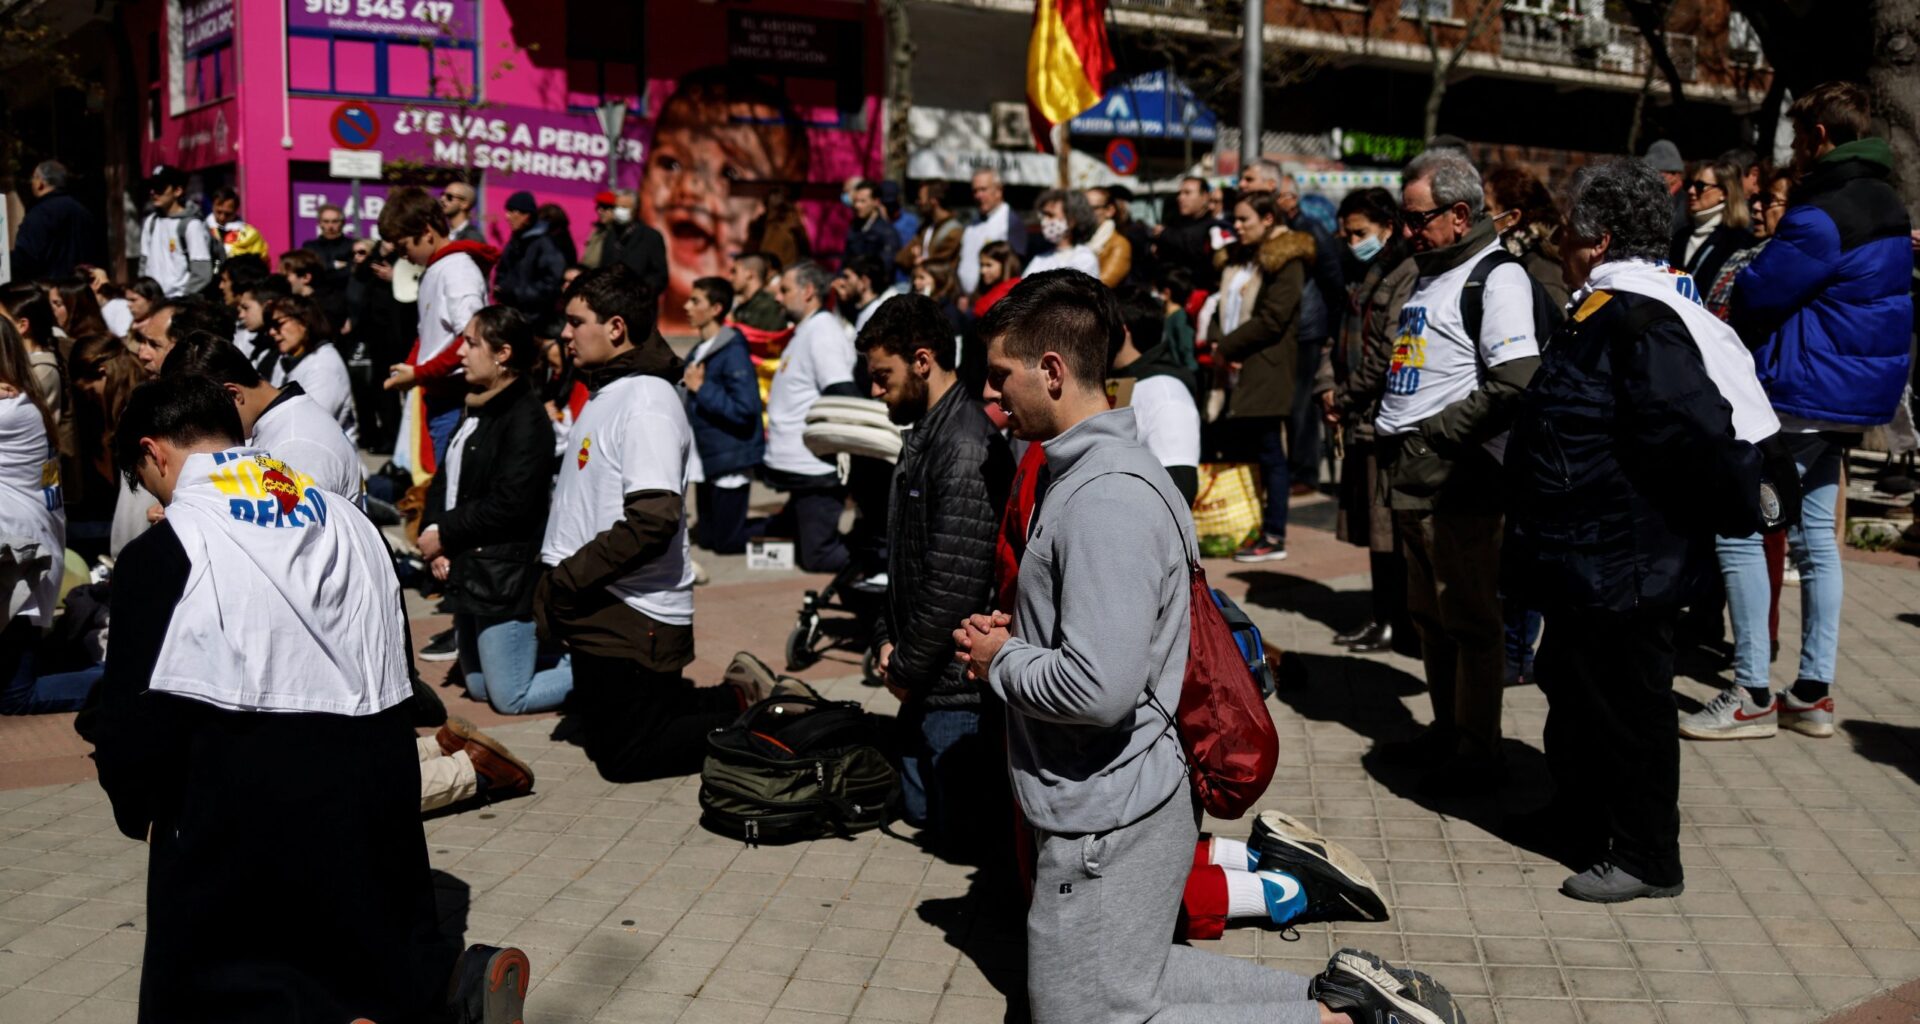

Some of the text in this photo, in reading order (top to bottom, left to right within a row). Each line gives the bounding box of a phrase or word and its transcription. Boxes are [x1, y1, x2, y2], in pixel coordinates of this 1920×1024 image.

[305, 0, 454, 24] 919 545 417
[394, 109, 445, 136] ¿TE
[449, 113, 508, 143] VAS
[511, 123, 534, 149] A
[434, 138, 607, 184] MI SONRISA?
